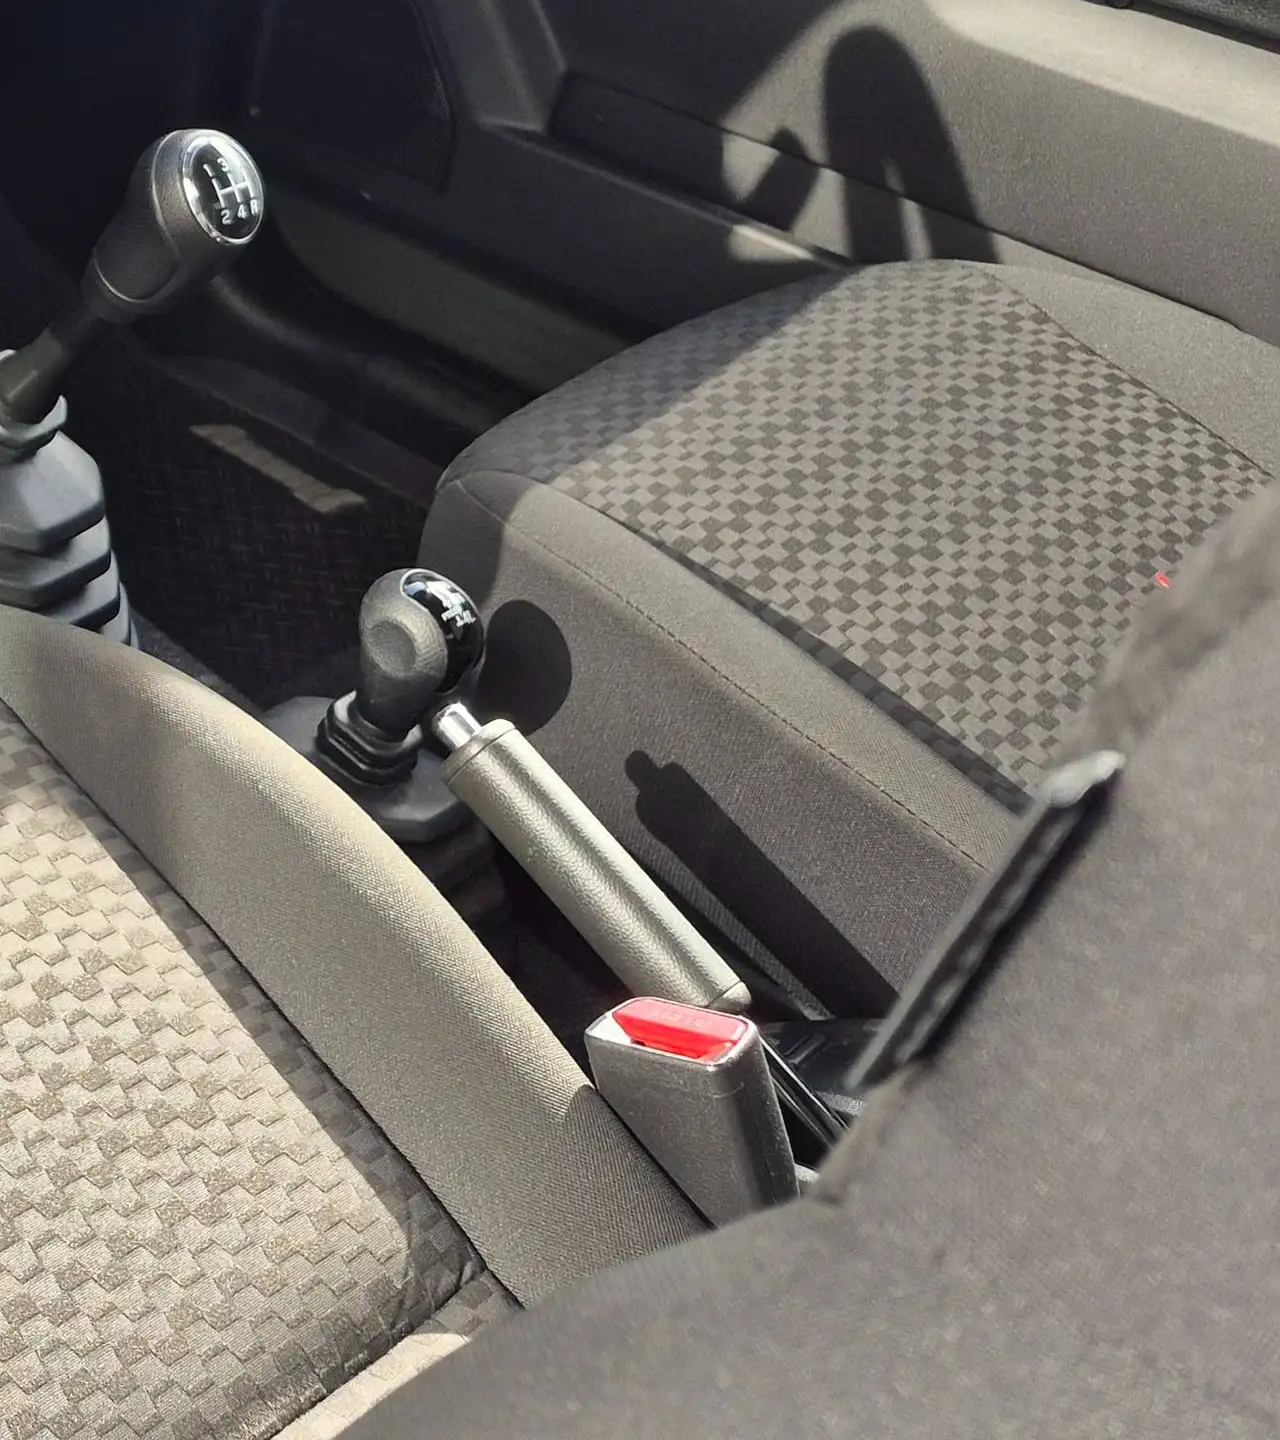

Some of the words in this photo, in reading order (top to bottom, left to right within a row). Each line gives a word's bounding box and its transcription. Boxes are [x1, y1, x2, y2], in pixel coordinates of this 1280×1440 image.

[203, 163, 213, 178] 1
[217, 157, 230, 173] 3
[220, 208, 232, 225] 2
[237, 203, 247, 219] 4
[250, 199, 259, 216] R
